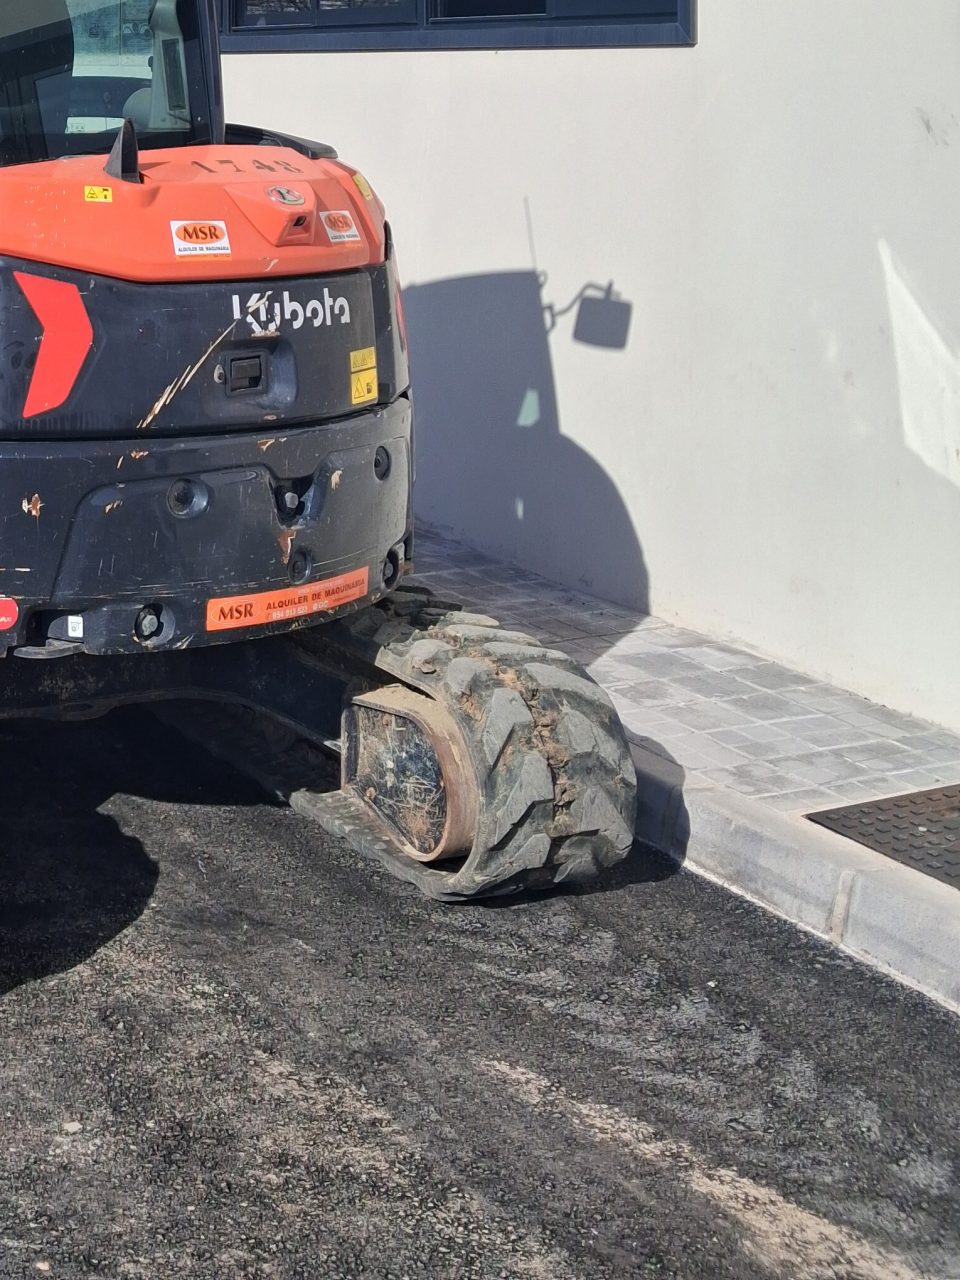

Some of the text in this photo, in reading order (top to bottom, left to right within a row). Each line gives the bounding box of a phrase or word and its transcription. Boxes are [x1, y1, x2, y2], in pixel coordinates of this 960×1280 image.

[183, 226, 221, 241] MSR
[232, 288, 351, 333] Kubota
[266, 596, 309, 610] ALQUILER
[311, 592, 322, 601] DE
[324, 578, 365, 598] MAQUINARIA
[218, 602, 254, 621] MSR
